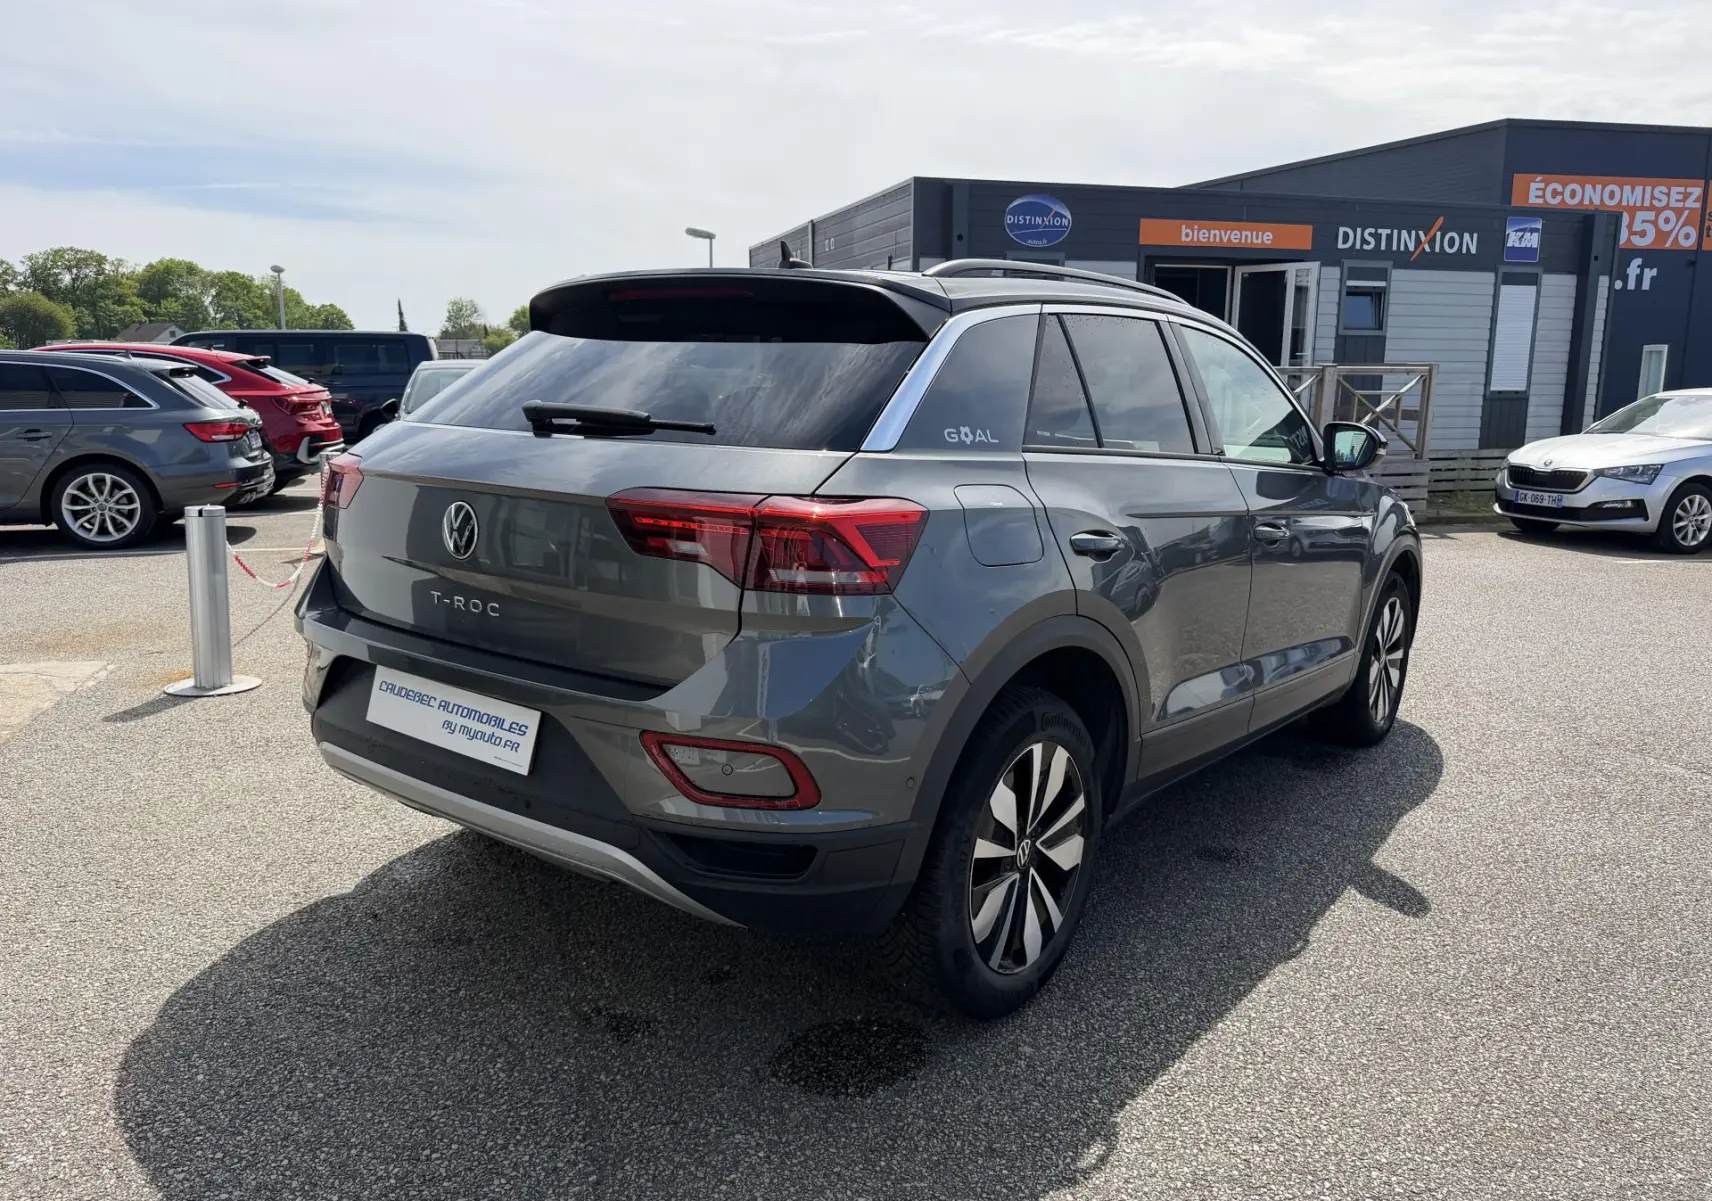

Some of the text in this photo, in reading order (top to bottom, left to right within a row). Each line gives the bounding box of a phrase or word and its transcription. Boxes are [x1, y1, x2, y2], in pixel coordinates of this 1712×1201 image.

[1528, 177, 1702, 208] ÉCONOMISEZ
[1006, 210, 1069, 227] DISTINXION
[1181, 224, 1273, 244] bienvenue
[1337, 217, 1478, 260] DISTINXION
[430, 590, 500, 617] T-ROC
[379, 680, 528, 736] CAUDEBEC AUTOMOBILES
